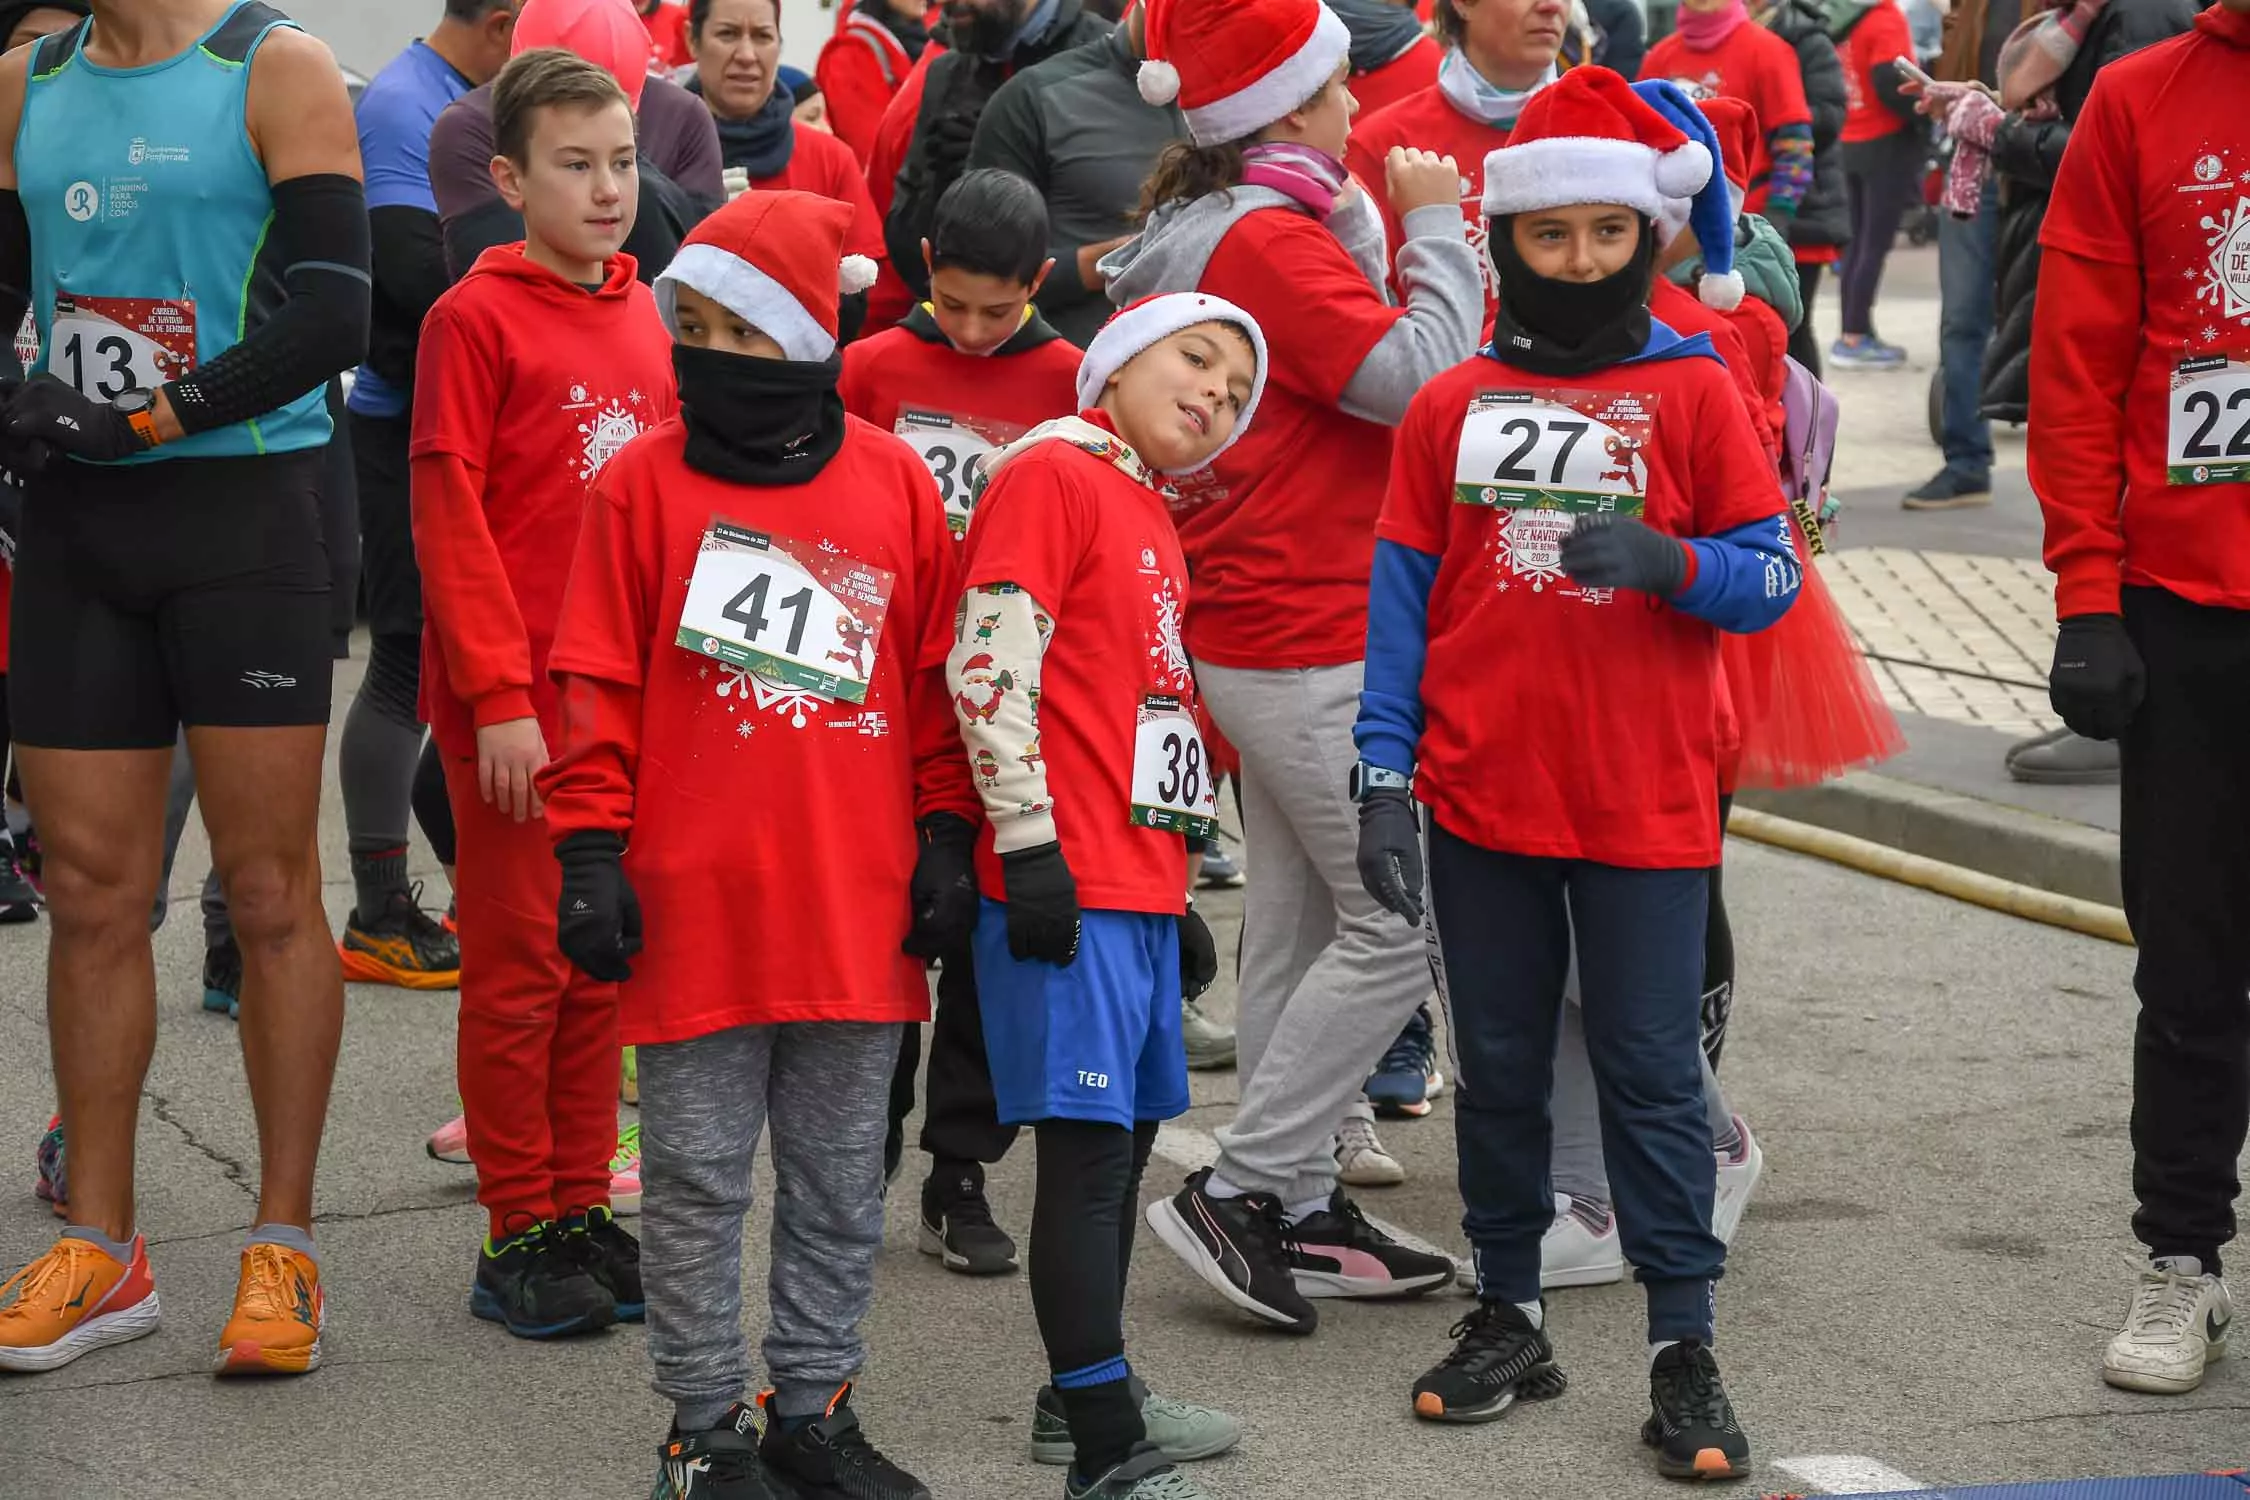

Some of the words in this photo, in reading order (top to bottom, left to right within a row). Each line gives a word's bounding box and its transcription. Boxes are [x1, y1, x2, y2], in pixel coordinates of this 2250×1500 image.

[2231, 254, 2249, 271] DE
[65, 333, 136, 401] 13
[2182, 387, 2250, 459] 22
[1494, 418, 1590, 484] 27
[1516, 529, 1528, 541] DE
[1531, 553, 1550, 562] 2023
[842, 576, 851, 587] DE
[852, 580, 878, 595] NAVIDAD
[849, 570, 875, 585] CARRERA
[831, 583, 846, 595] VILLA
[847, 588, 857, 598] DE
[857, 591, 886, 607] BEMBIBRE
[721, 572, 814, 656] 41
[1158, 732, 1200, 808] 38
[1077, 1070, 1108, 1089] TEO
